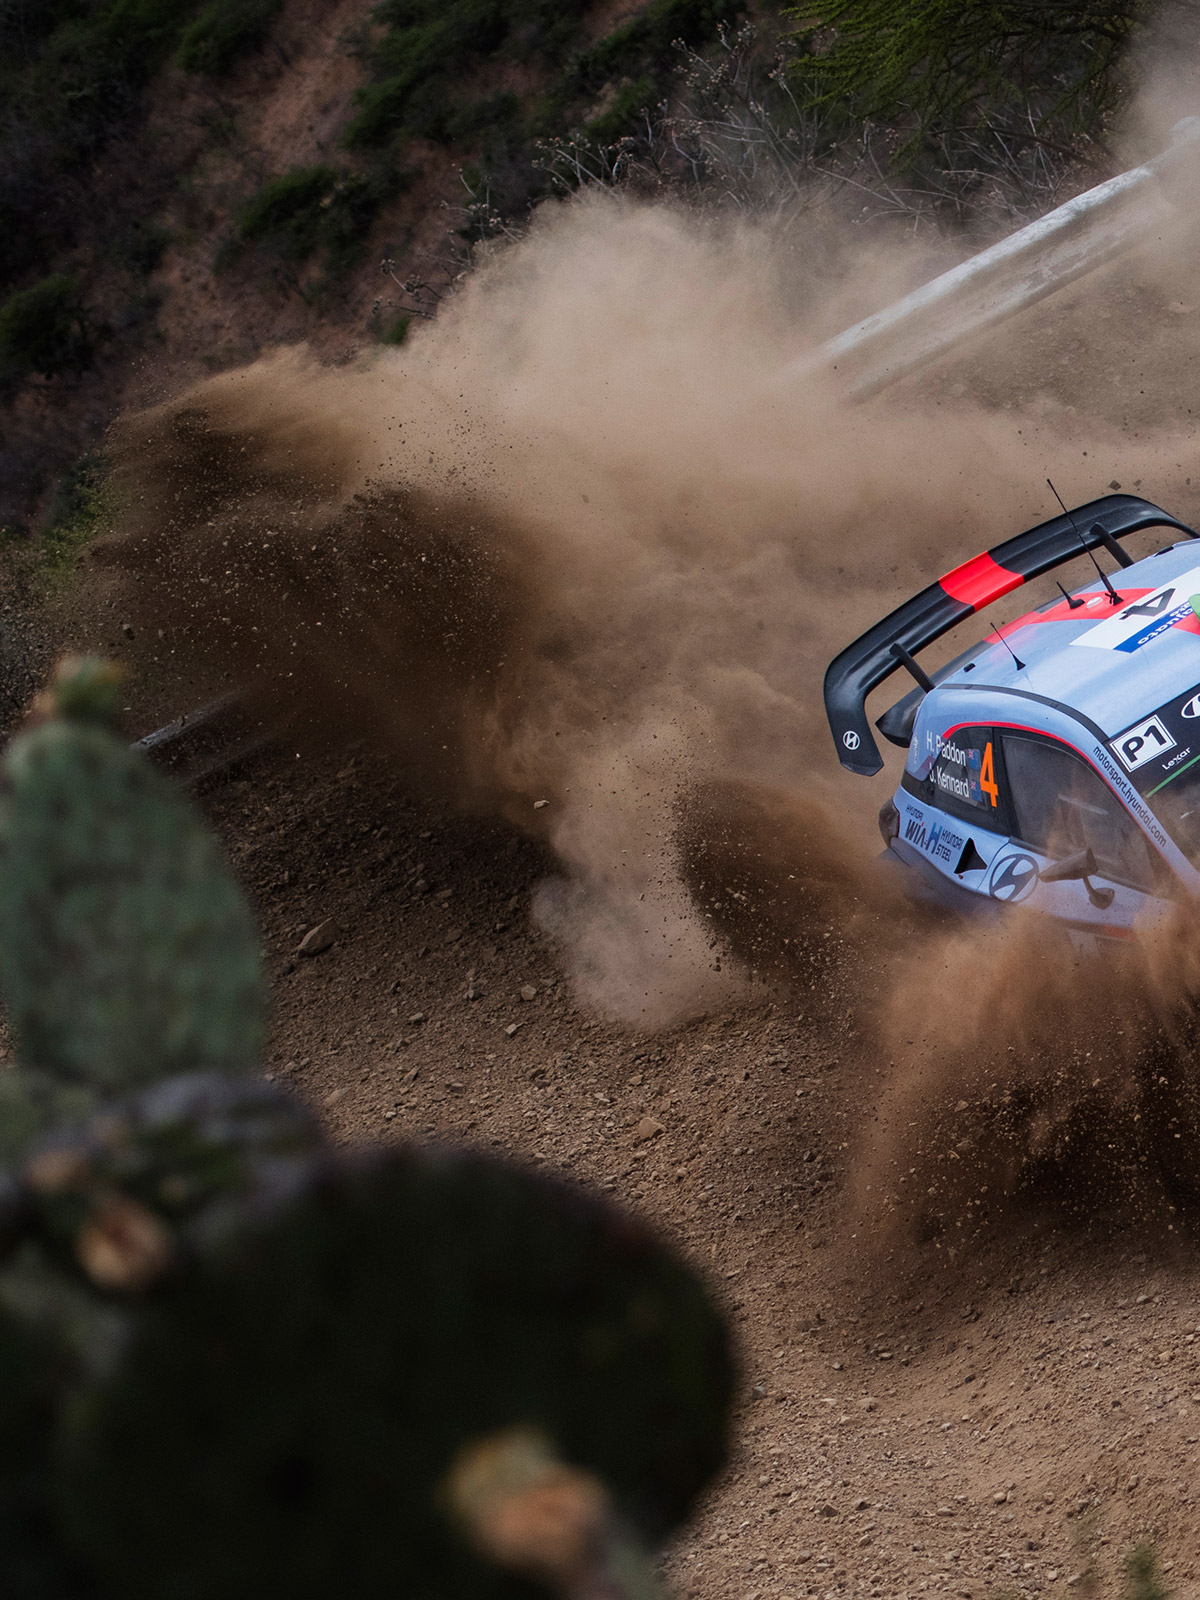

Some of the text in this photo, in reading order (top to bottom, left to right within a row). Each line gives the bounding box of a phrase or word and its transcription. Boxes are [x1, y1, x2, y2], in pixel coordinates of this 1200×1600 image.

[1119, 588, 1176, 620] 4
[926, 730, 935, 752] H.
[936, 735, 966, 767] Paddon
[1121, 724, 1168, 763] P1
[1162, 747, 1191, 770] Lexar
[929, 762, 970, 798] J. Kennard
[980, 741, 998, 808] 4
[1093, 746, 1167, 848] motorsport.hyundai.com
[935, 843, 952, 862] STEEL
